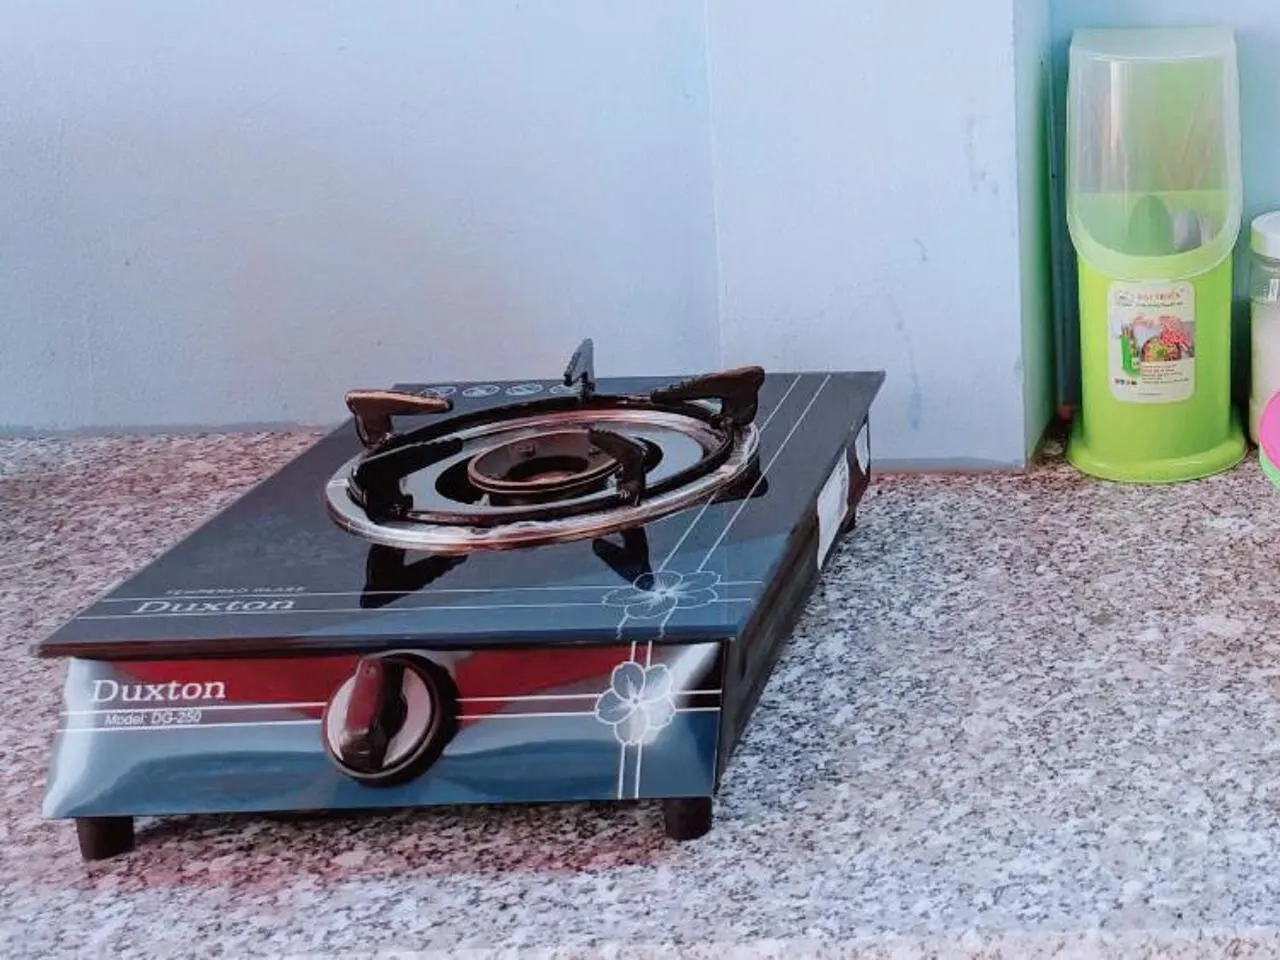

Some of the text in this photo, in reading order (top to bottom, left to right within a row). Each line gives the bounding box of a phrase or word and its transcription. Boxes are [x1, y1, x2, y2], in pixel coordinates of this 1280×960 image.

[131, 598, 297, 614] Duxton
[90, 679, 227, 703] Duxton
[104, 708, 202, 726] Model: DG-250
